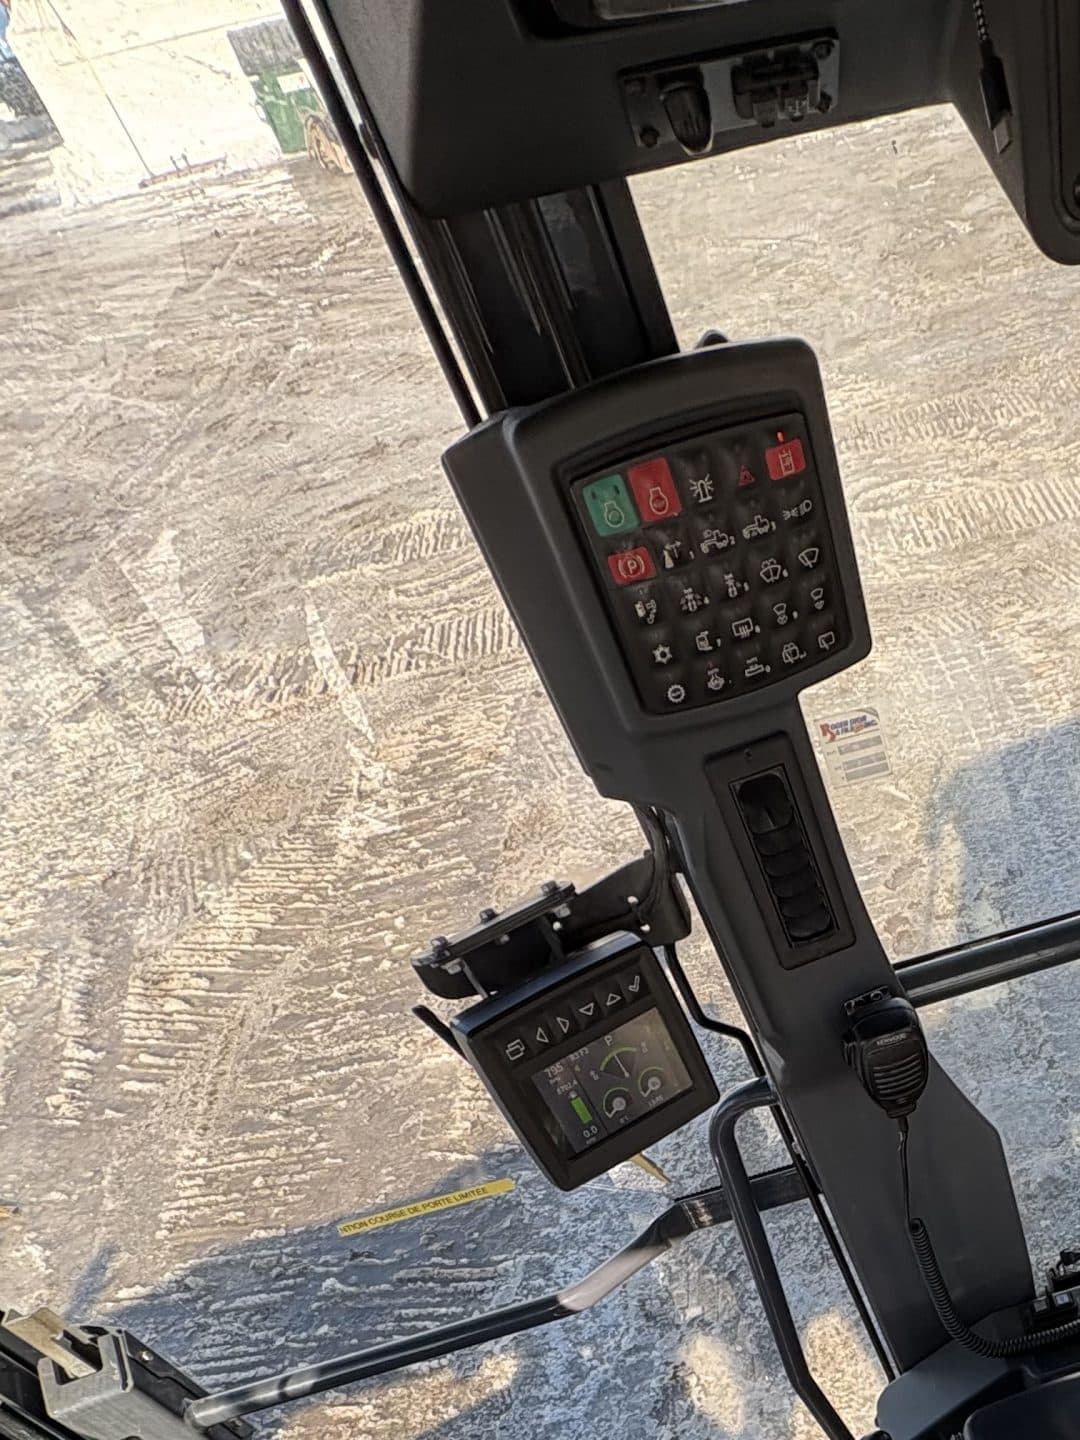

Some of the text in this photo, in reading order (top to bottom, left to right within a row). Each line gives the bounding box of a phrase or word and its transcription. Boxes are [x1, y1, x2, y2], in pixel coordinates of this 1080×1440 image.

[545, 1063, 564, 1079] 795
[582, 1124, 598, 1139] 0.0
[368, 1210, 408, 1228] COURSE
[408, 1205, 422, 1216] DE
[422, 1195, 455, 1212] PORTE
